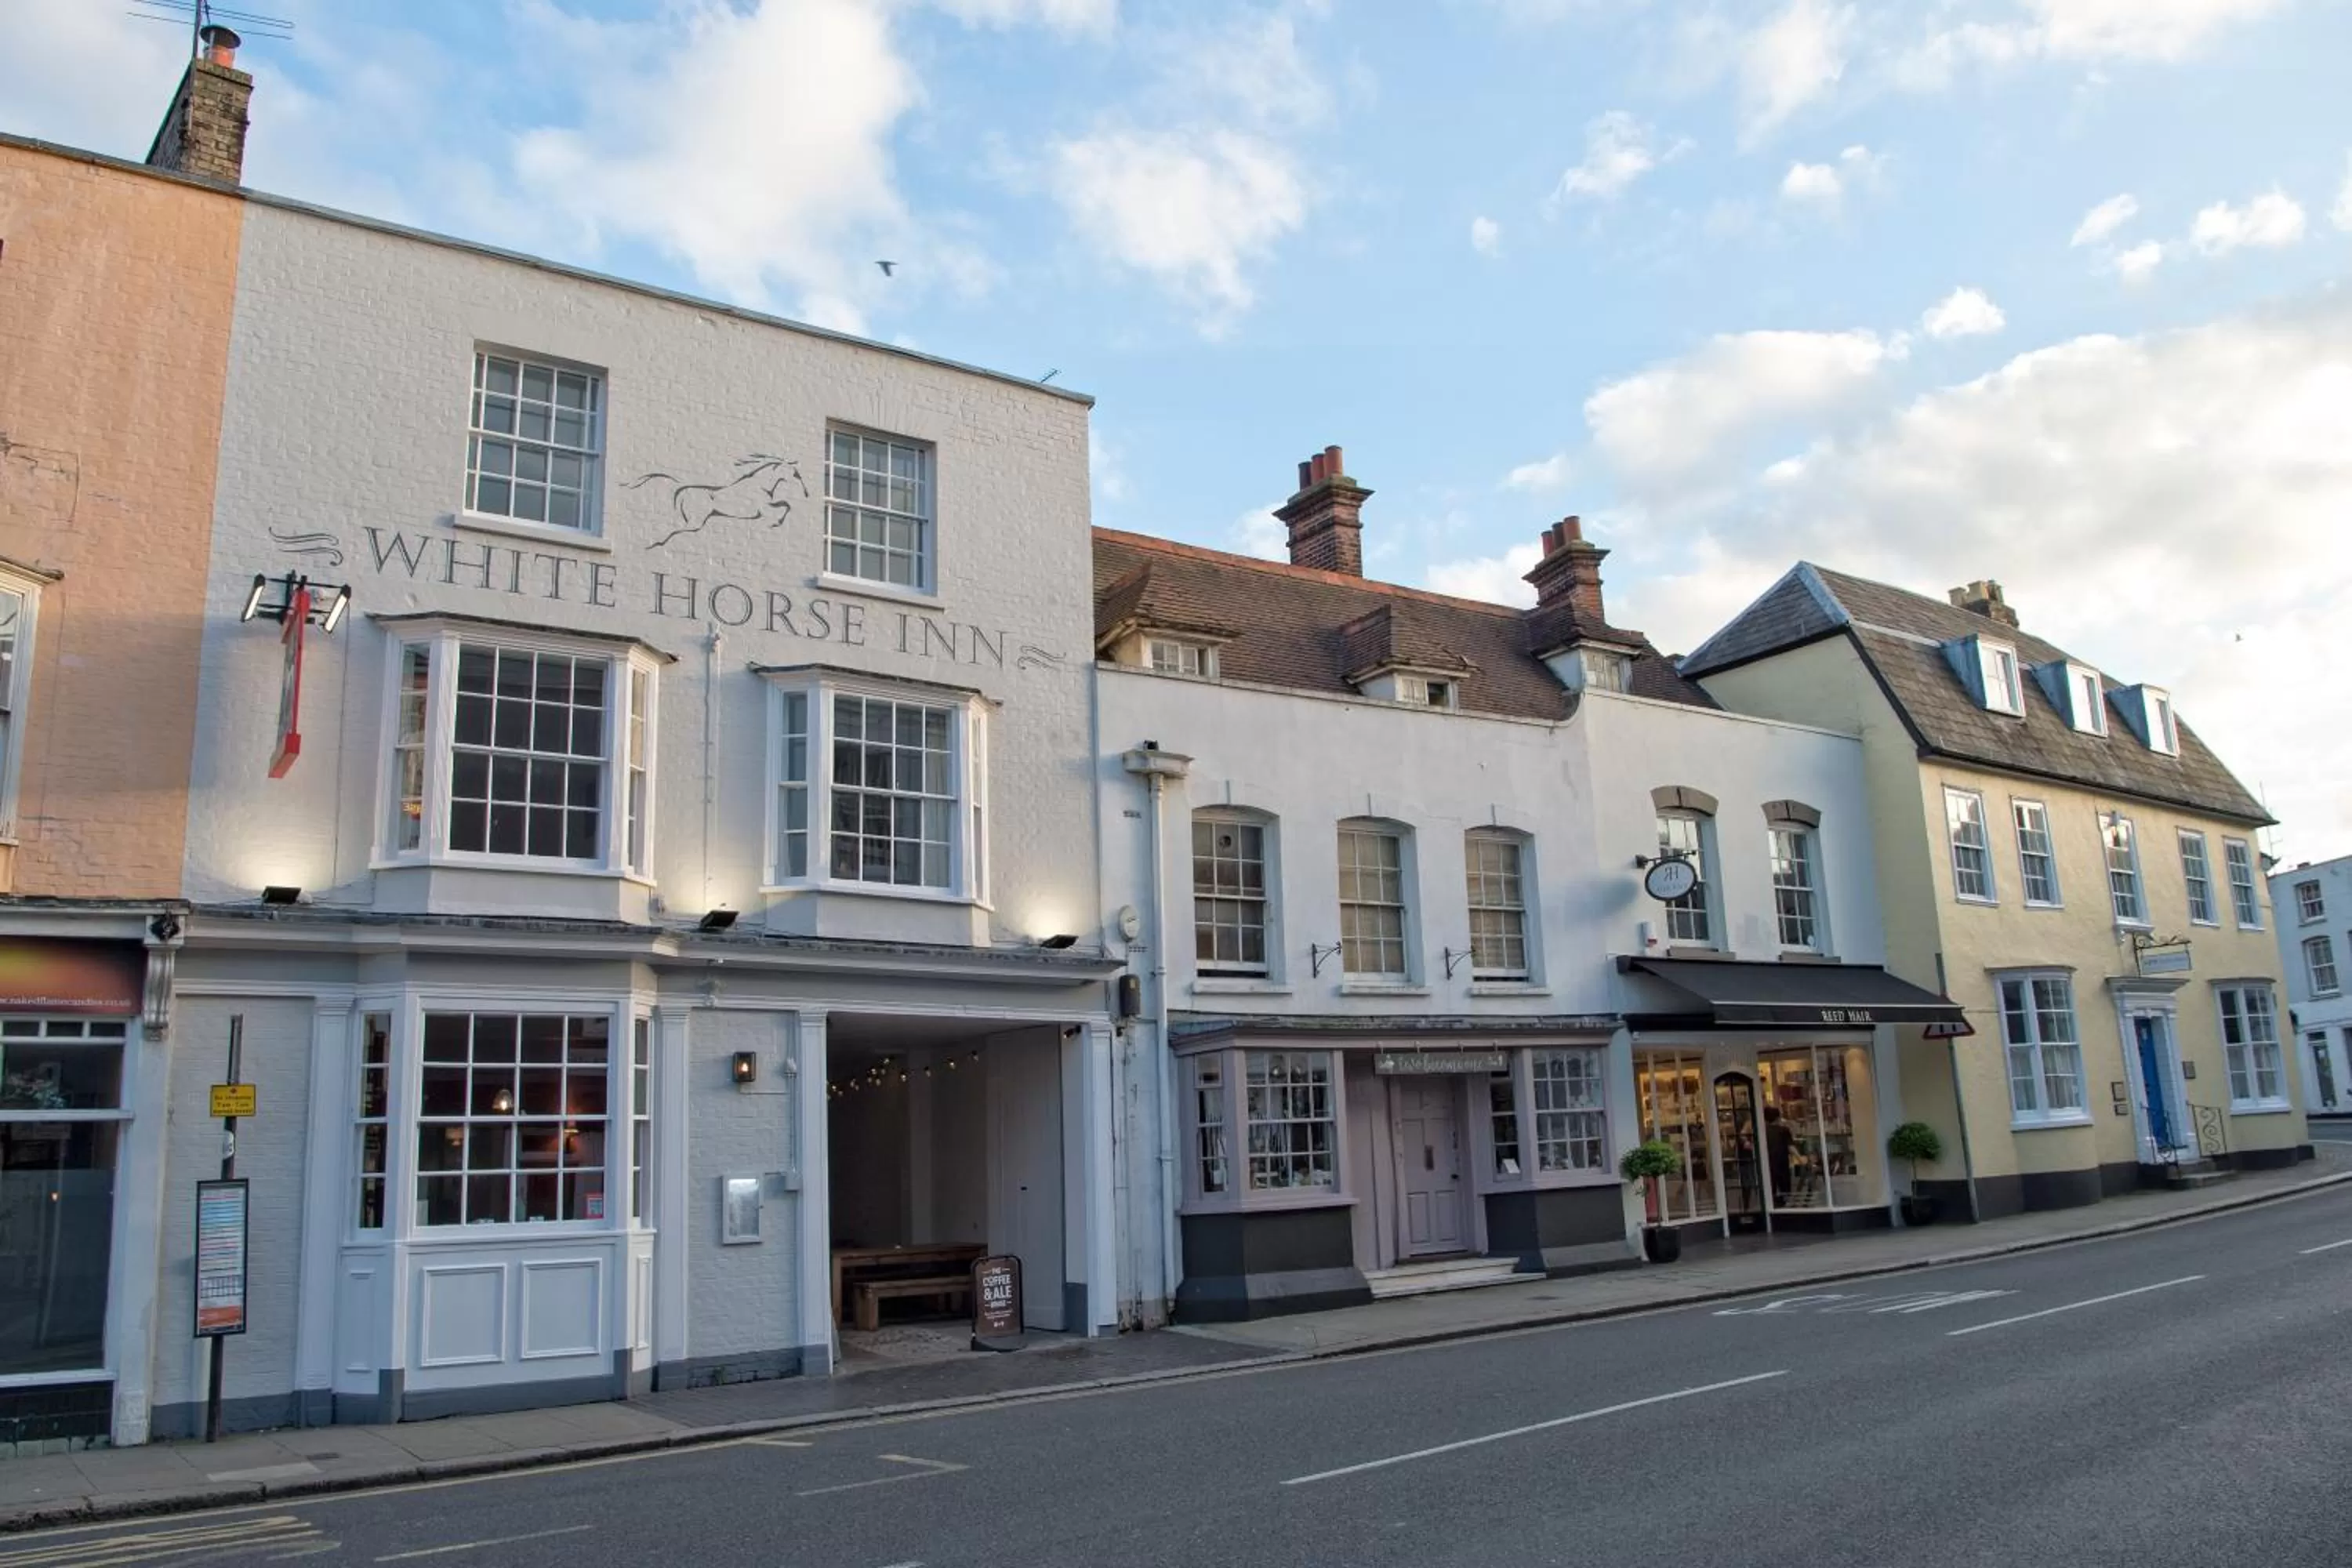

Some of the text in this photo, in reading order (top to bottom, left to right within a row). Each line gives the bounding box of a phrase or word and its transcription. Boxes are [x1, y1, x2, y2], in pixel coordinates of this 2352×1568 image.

[363, 526, 1018, 668] WHITE HORSE INN
[1820, 1008, 1872, 1022] REED HAIR
[982, 1274, 1011, 1287] COFFEE
